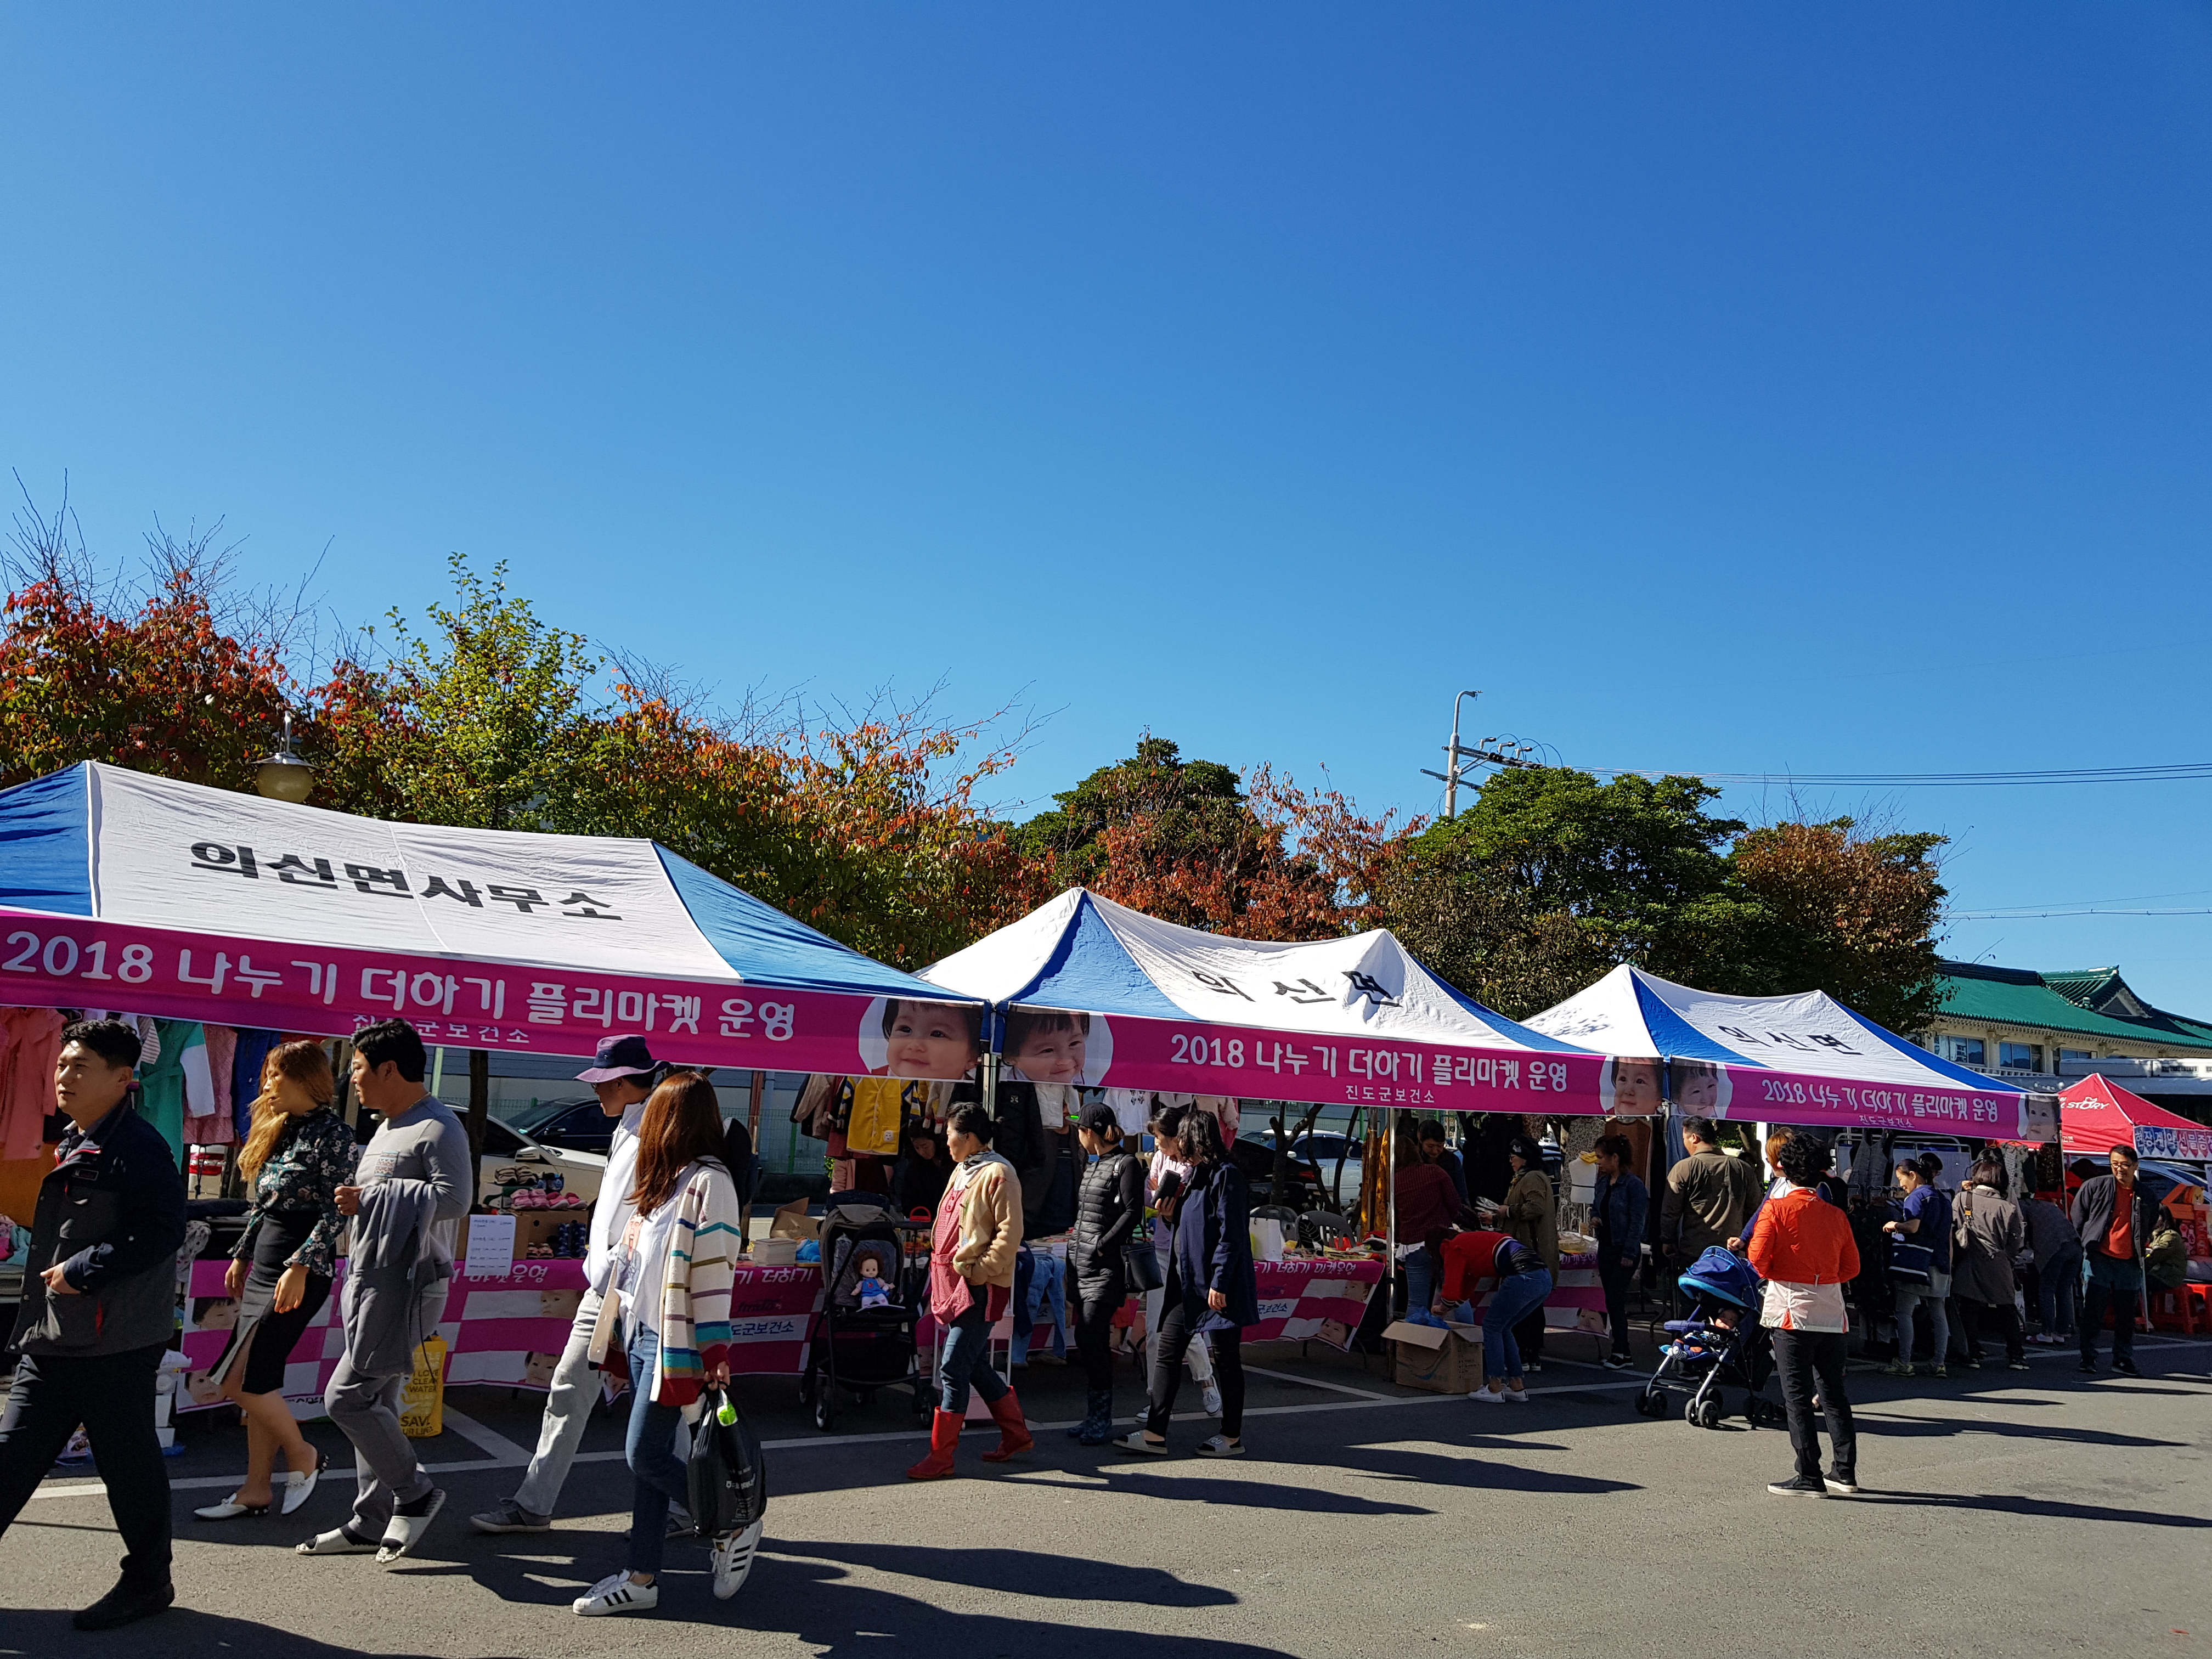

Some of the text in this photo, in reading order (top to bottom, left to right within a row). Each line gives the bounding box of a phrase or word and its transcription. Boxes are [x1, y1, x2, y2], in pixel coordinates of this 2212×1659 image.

[190, 841, 623, 921] 의신면사무소
[2, 931, 795, 1041] 2018 나누기 더하기 플리마켓 운영
[1171, 1034, 1567, 1092] 2018 나누기 더하기 플리마켓 운영
[1345, 1085, 1435, 1104] 진도군보건소
[1762, 1079, 1998, 1122] 2018 나누기 더하기 플리마켓 운영
[1859, 1115, 1915, 1128] 진도군보건소
[2135, 1130, 2177, 1149] 현장계약
[761, 1267, 814, 1283] 더하기
[1276, 1261, 1311, 1273] 더하기
